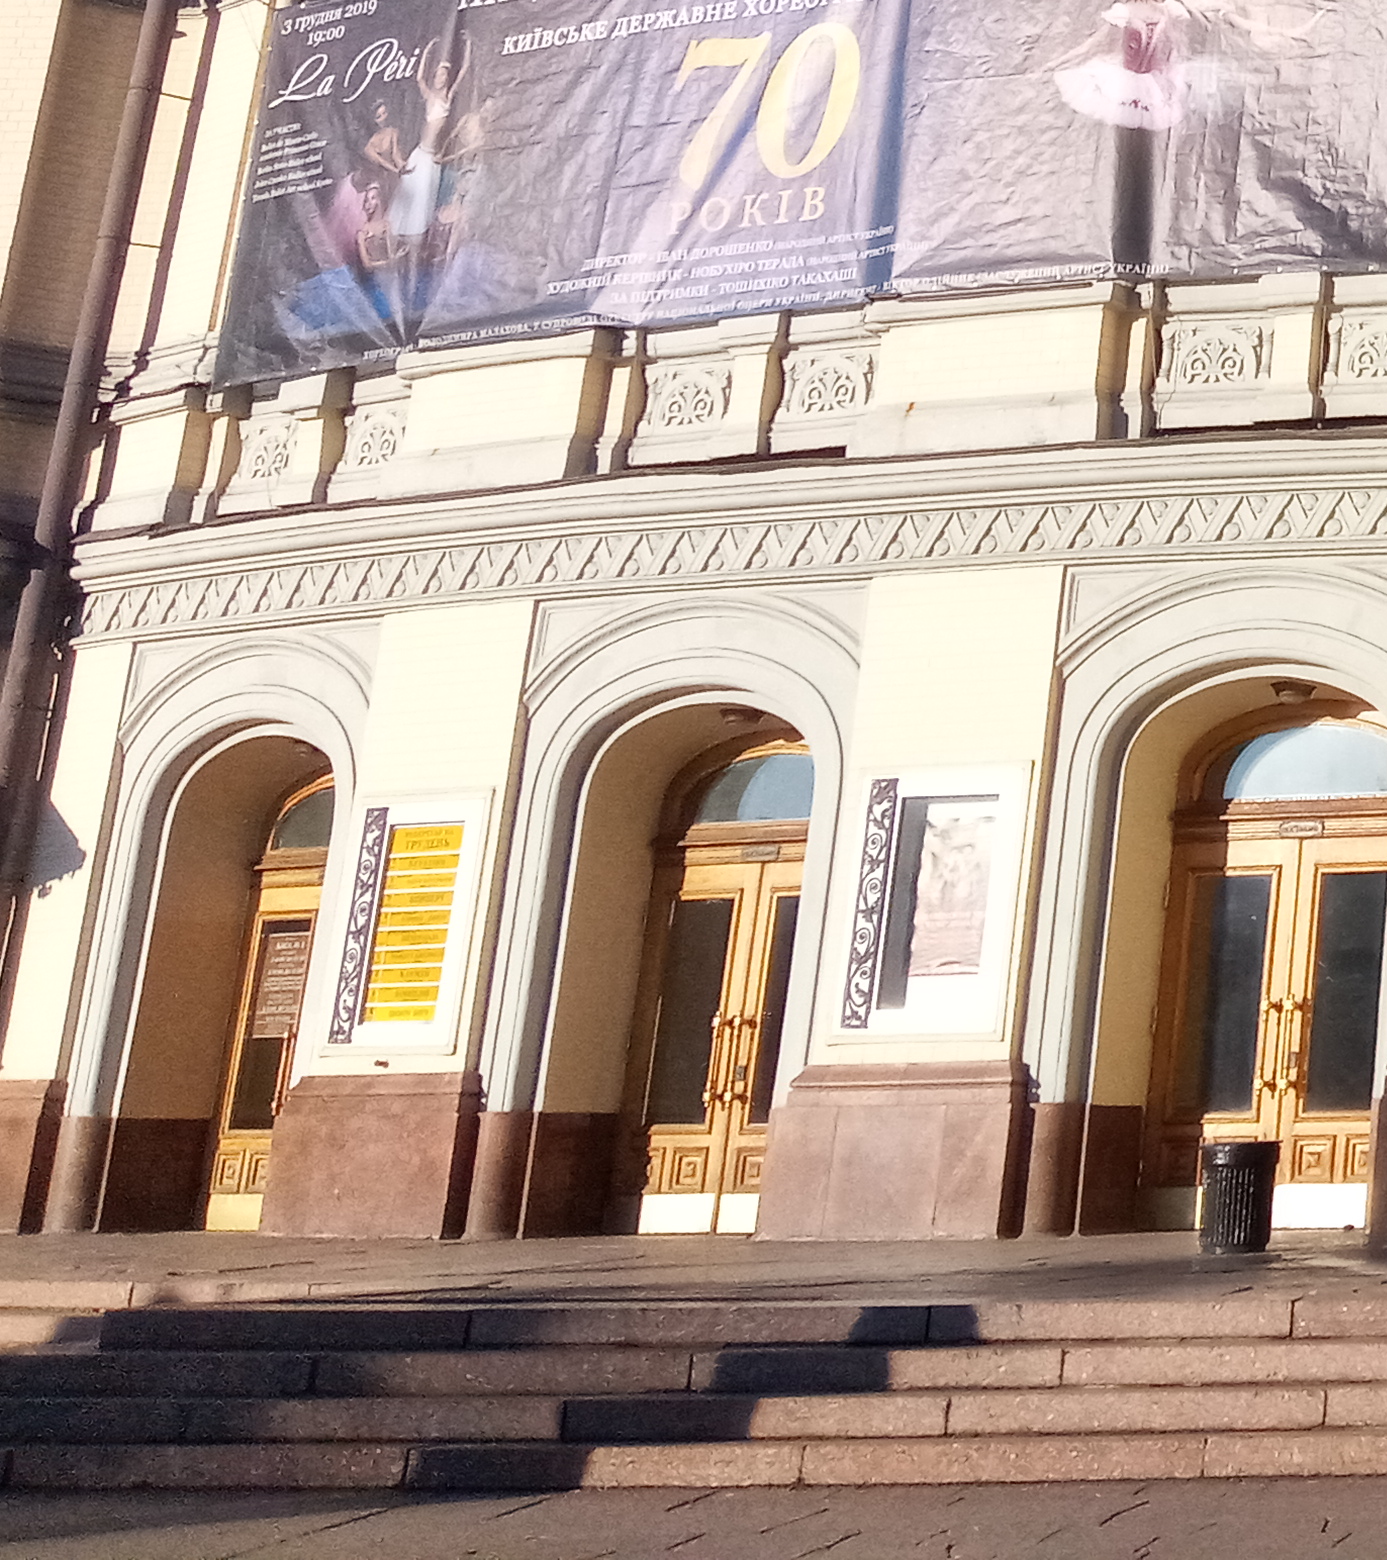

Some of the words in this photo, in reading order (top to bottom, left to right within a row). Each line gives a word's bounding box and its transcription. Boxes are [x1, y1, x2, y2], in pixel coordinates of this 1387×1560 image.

[280, 18, 293, 36] 3
[294, 7, 343, 32] грудня
[307, 25, 345, 47] 19:00
[501, 19, 606, 56] КИЇВСЬКЕ
[611, 0, 738, 39] ДЕРЖАВНЕ
[268, 53, 335, 109] La
[342, 37, 421, 103] Péri
[673, 21, 861, 191] 70
[668, 186, 827, 237] РОКІВ
[580, 252, 647, 272] ДИРЕКТОР
[689, 239, 774, 261] ДОРОШЕНКО
